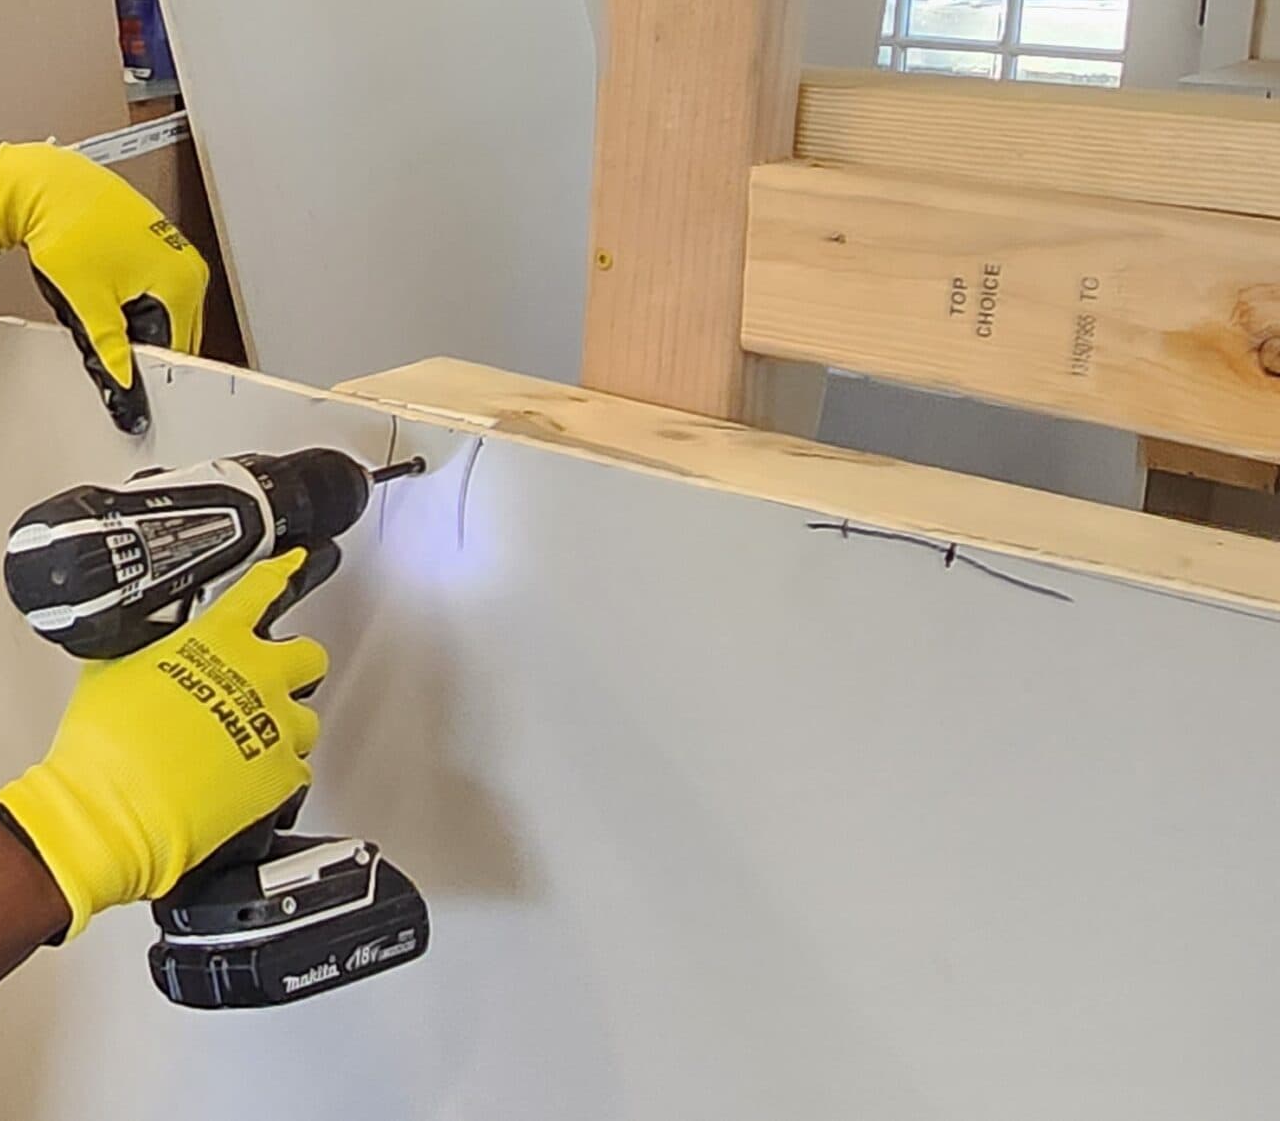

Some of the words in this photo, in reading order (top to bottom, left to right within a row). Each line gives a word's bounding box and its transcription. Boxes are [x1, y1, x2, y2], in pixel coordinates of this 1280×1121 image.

[949, 277, 969, 317] TOP
[976, 263, 1002, 338] CHOICE
[157, 661, 216, 703] GRIP
[210, 700, 261, 761] FIRM
